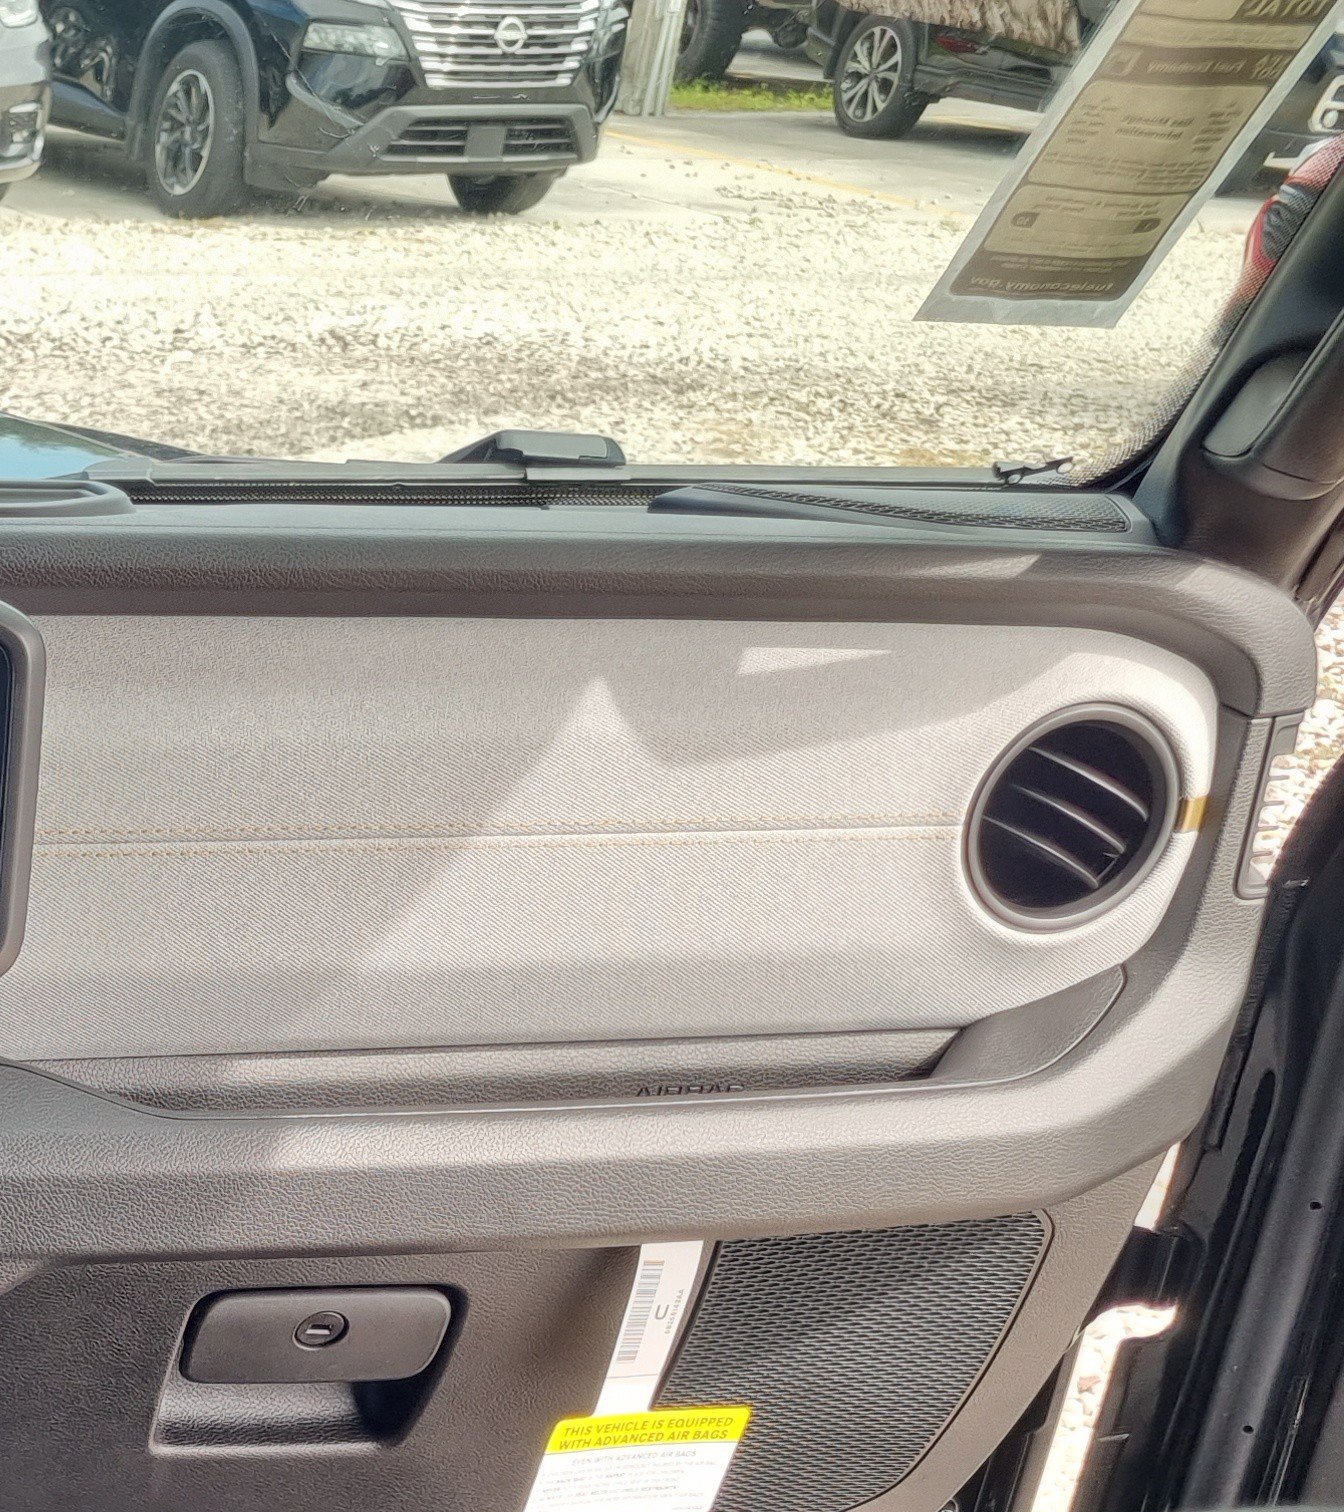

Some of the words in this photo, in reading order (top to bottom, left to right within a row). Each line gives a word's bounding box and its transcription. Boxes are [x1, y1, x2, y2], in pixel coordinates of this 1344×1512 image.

[564, 1425, 592, 1437] THIS
[595, 1419, 649, 1434] VEHICLE
[651, 1418, 664, 1430] IS
[667, 1416, 734, 1430] EQUIPPED
[558, 1438, 592, 1450] WITH
[594, 1432, 664, 1447] ADVANCED
[666, 1431, 691, 1442] AIR
[693, 1429, 729, 1440] BAGS
